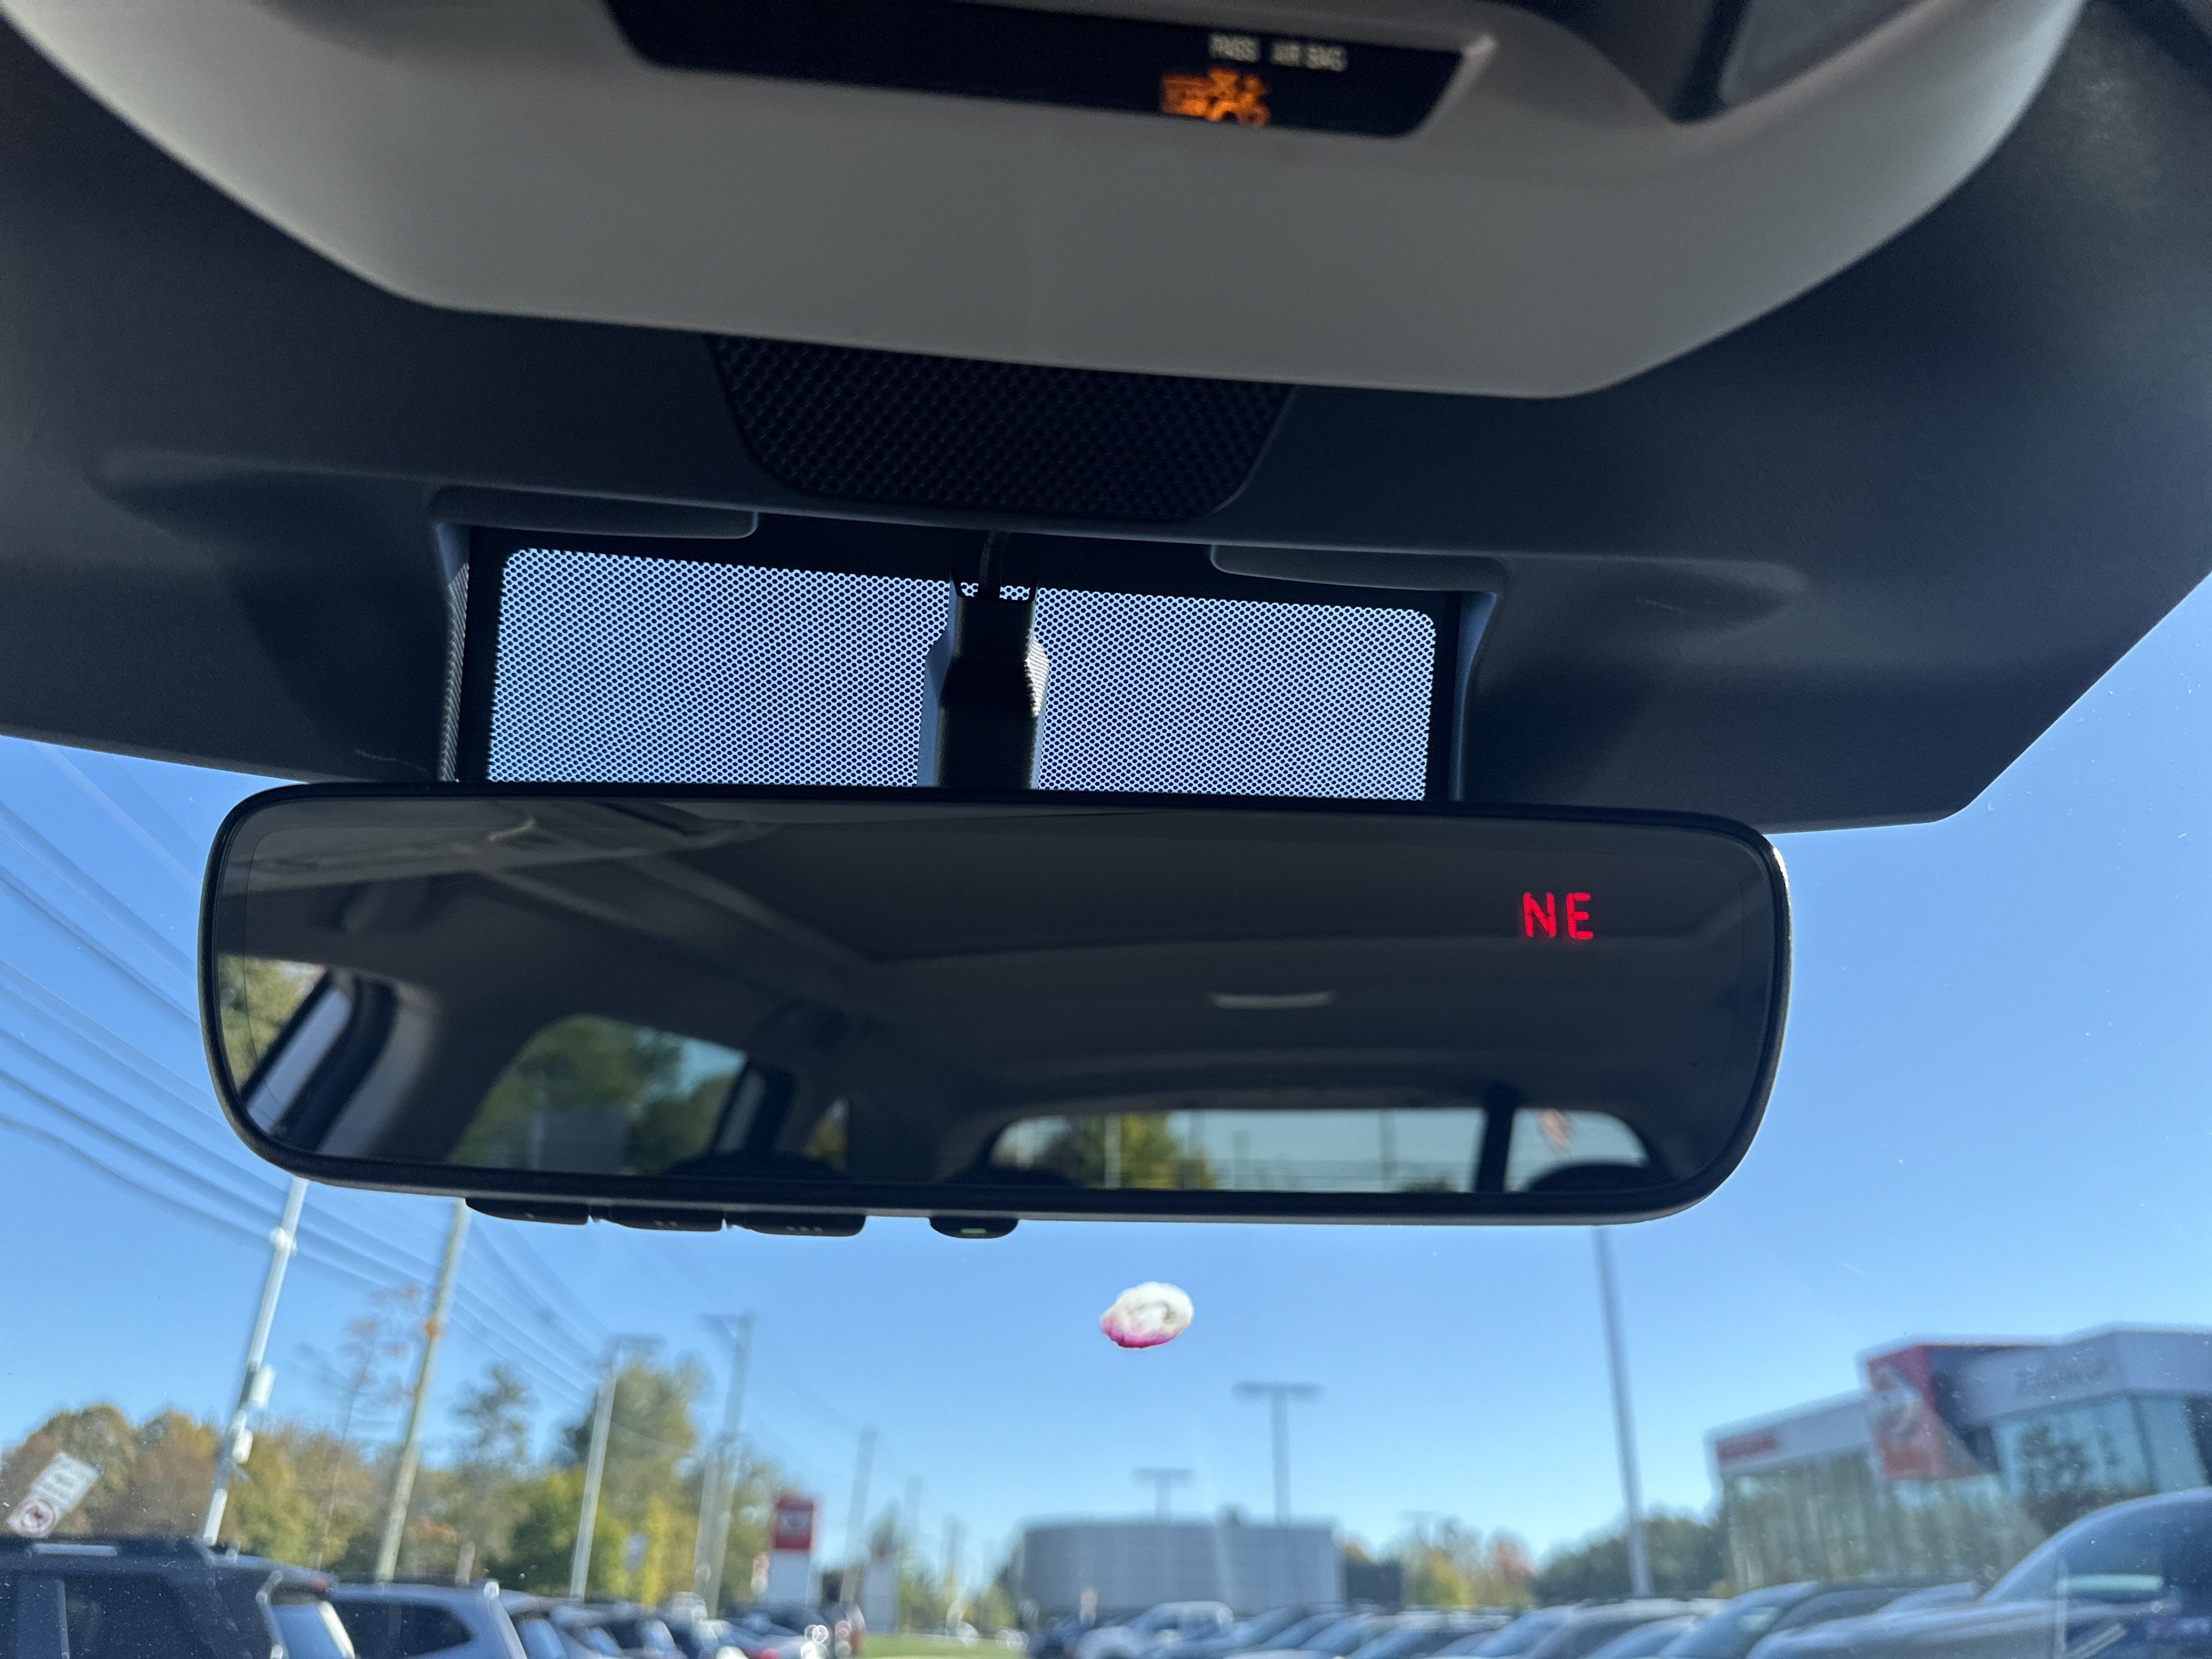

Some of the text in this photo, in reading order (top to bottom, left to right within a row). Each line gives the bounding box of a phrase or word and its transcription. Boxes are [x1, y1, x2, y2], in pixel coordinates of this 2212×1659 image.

[1210, 35, 1347, 72] PASS AIR BAG
[1523, 892, 1593, 939] NE
